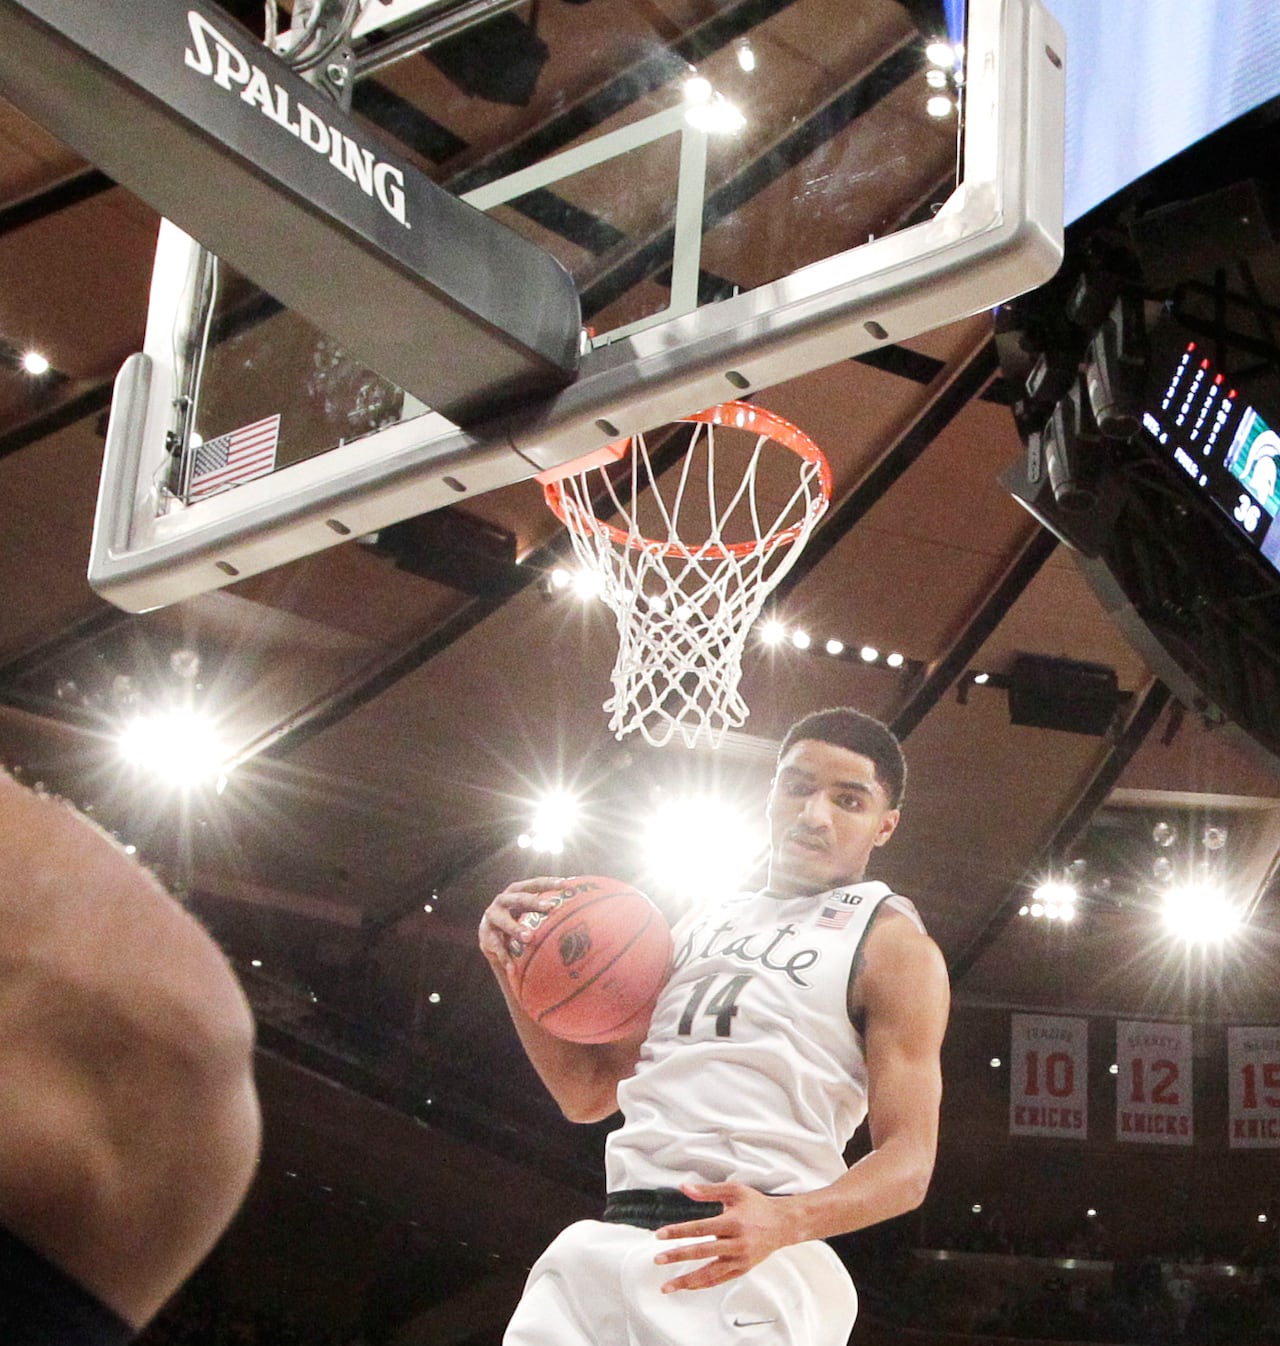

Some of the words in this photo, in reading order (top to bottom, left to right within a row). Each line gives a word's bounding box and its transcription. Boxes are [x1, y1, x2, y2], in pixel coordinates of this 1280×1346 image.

[184, 9, 408, 225] SPALDING
[1234, 494, 1261, 532] 36
[673, 920, 822, 990] State
[677, 973, 754, 1037] 14
[1024, 1051, 1074, 1097] 10
[1131, 1058, 1179, 1105] 12
[1014, 1106, 1082, 1129] KNICKS
[1121, 1112, 1189, 1135] KNICKS
